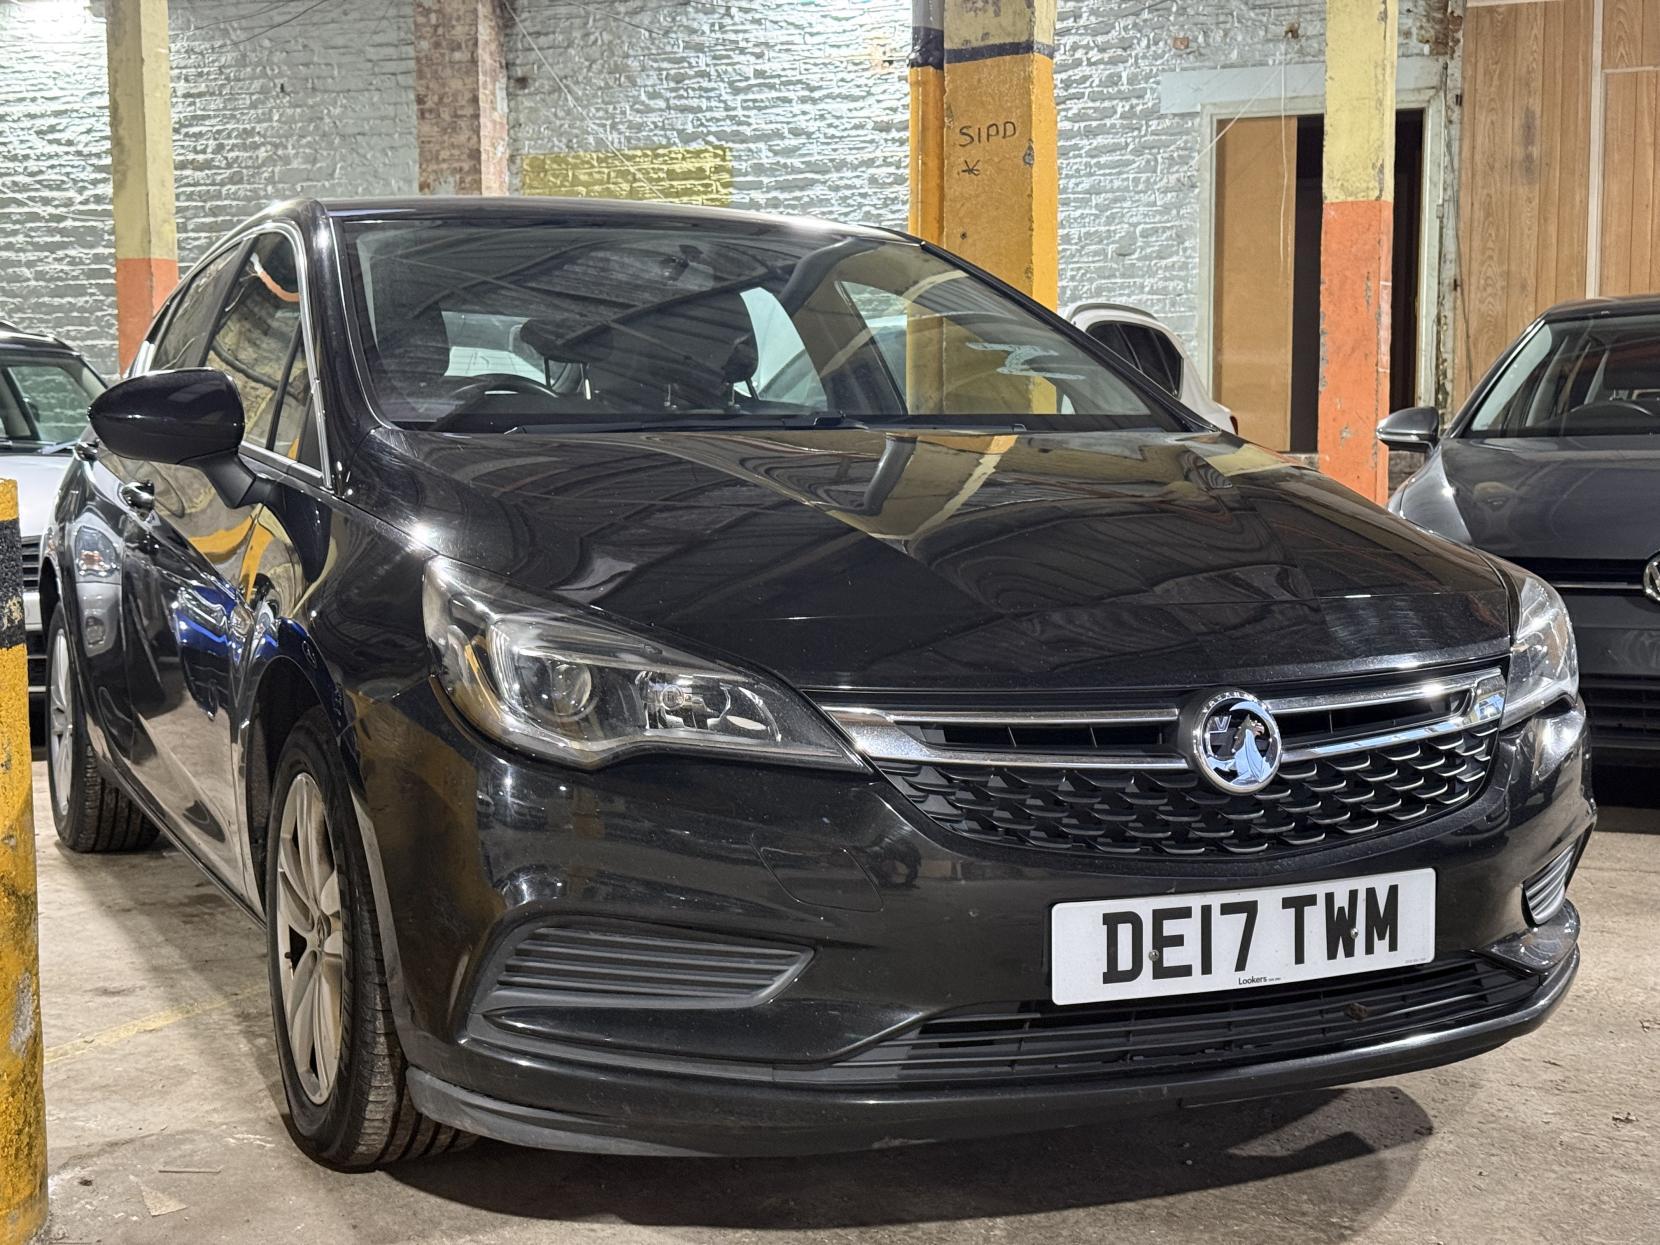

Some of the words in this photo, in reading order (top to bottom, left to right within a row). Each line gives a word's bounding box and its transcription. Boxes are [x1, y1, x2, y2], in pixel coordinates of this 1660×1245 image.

[1102, 899, 1259, 984] DE17
[1281, 884, 1399, 966] TWM
[1238, 976, 1267, 985] Lookers
